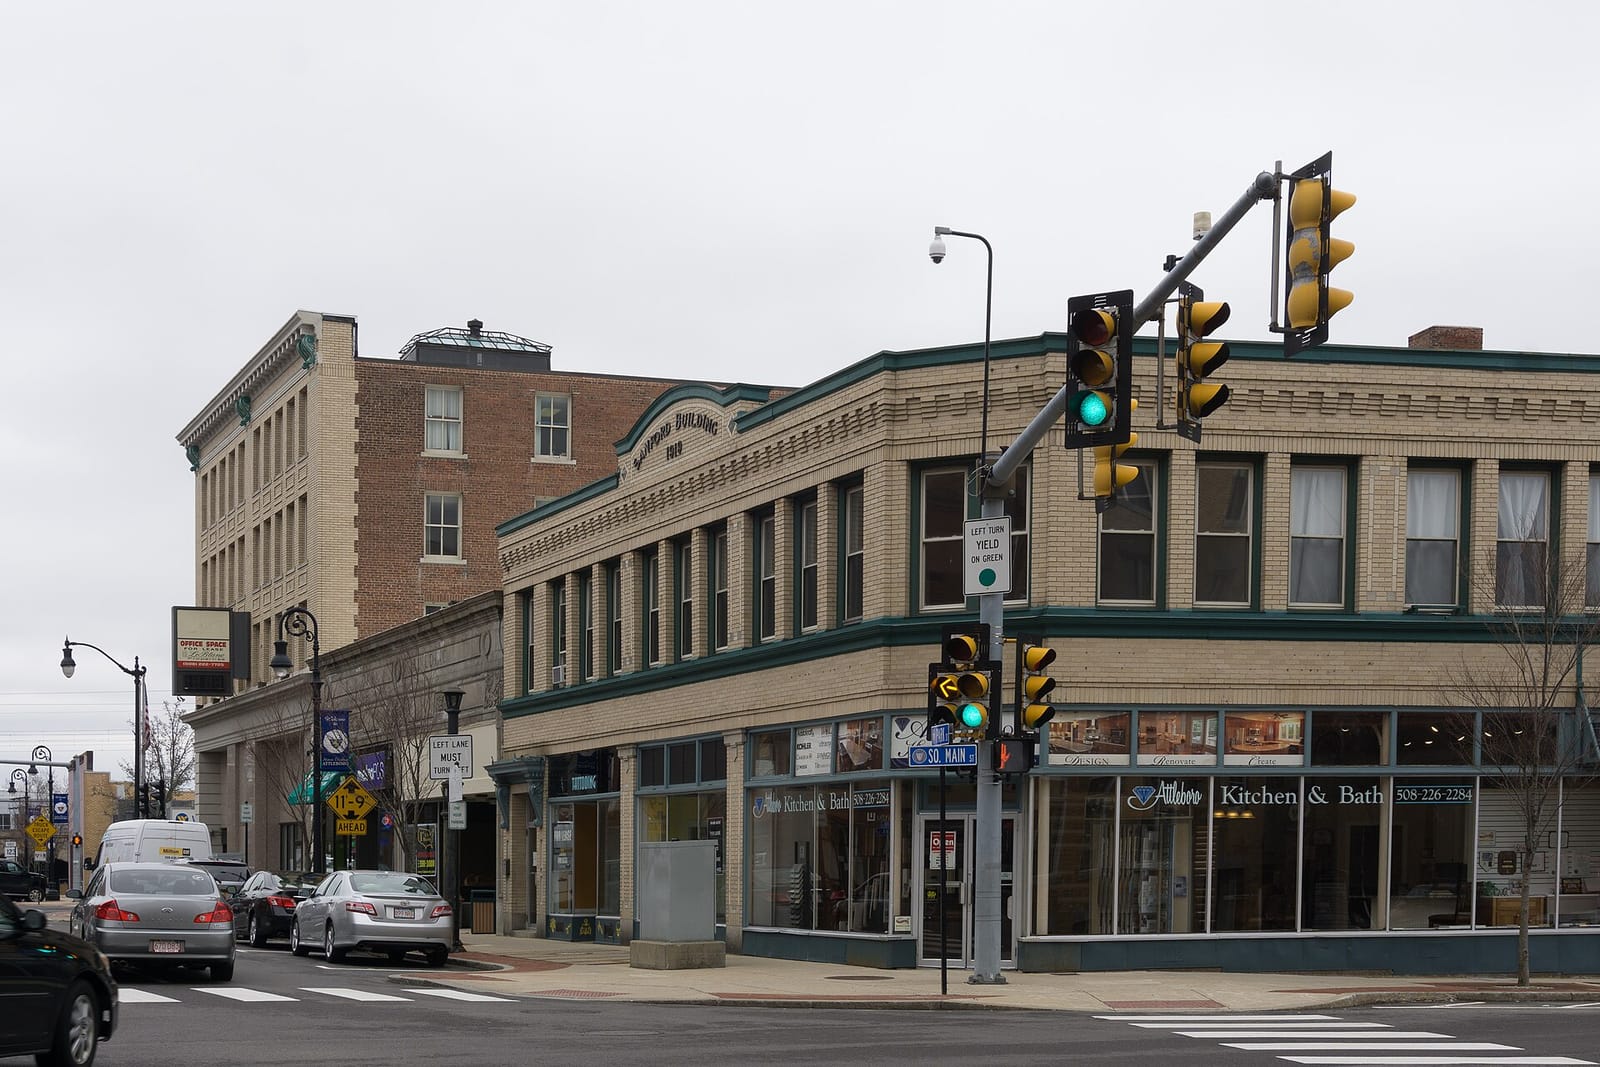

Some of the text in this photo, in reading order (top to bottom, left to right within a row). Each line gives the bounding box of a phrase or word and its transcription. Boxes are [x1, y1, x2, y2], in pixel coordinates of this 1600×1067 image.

[675, 412, 718, 436] BUILDING
[971, 525, 1005, 536] LEFT TURN
[976, 538, 1000, 550] YIELD
[970, 552, 1003, 564] ON GREEN
[432, 740, 469, 749] LEFT LANE
[440, 752, 462, 762] MUST
[927, 747, 975, 764] SO. MAIN ST
[1152, 755, 1197, 767] Renovate
[1247, 755, 1277, 767] Create
[433, 766, 451, 775] TURN
[1155, 780, 1385, 805] Attleboro Kitchen & Bath
[1396, 788, 1473, 801] 508-226-2284
[783, 794, 814, 813] Kitchen
[816, 793, 826, 811] &
[829, 791, 850, 811] Bath
[338, 822, 366, 832] AHEAD
